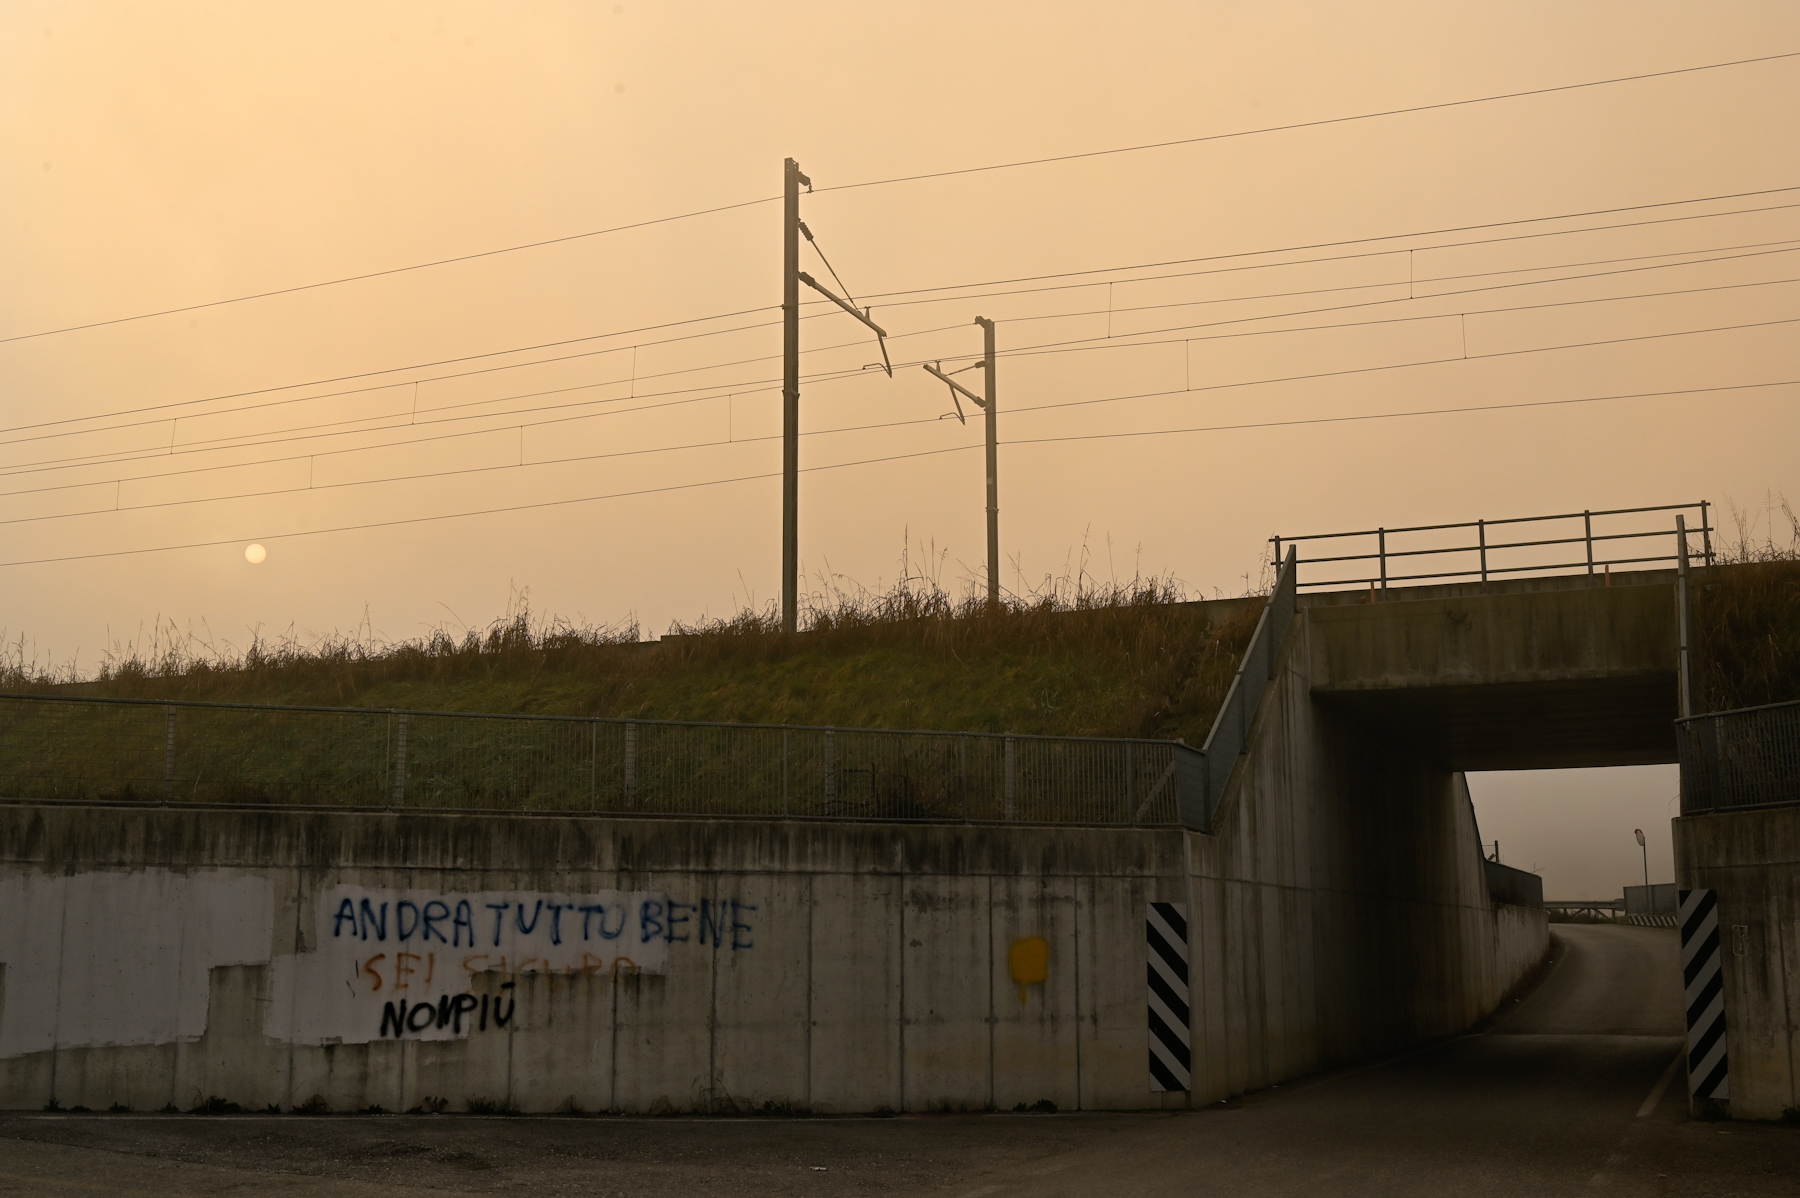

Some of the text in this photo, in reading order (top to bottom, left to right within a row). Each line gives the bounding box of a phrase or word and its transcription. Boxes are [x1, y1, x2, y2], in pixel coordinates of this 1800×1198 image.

[333, 897, 759, 951] ANDRA TUTTO BENE
[363, 951, 435, 992] SEI
